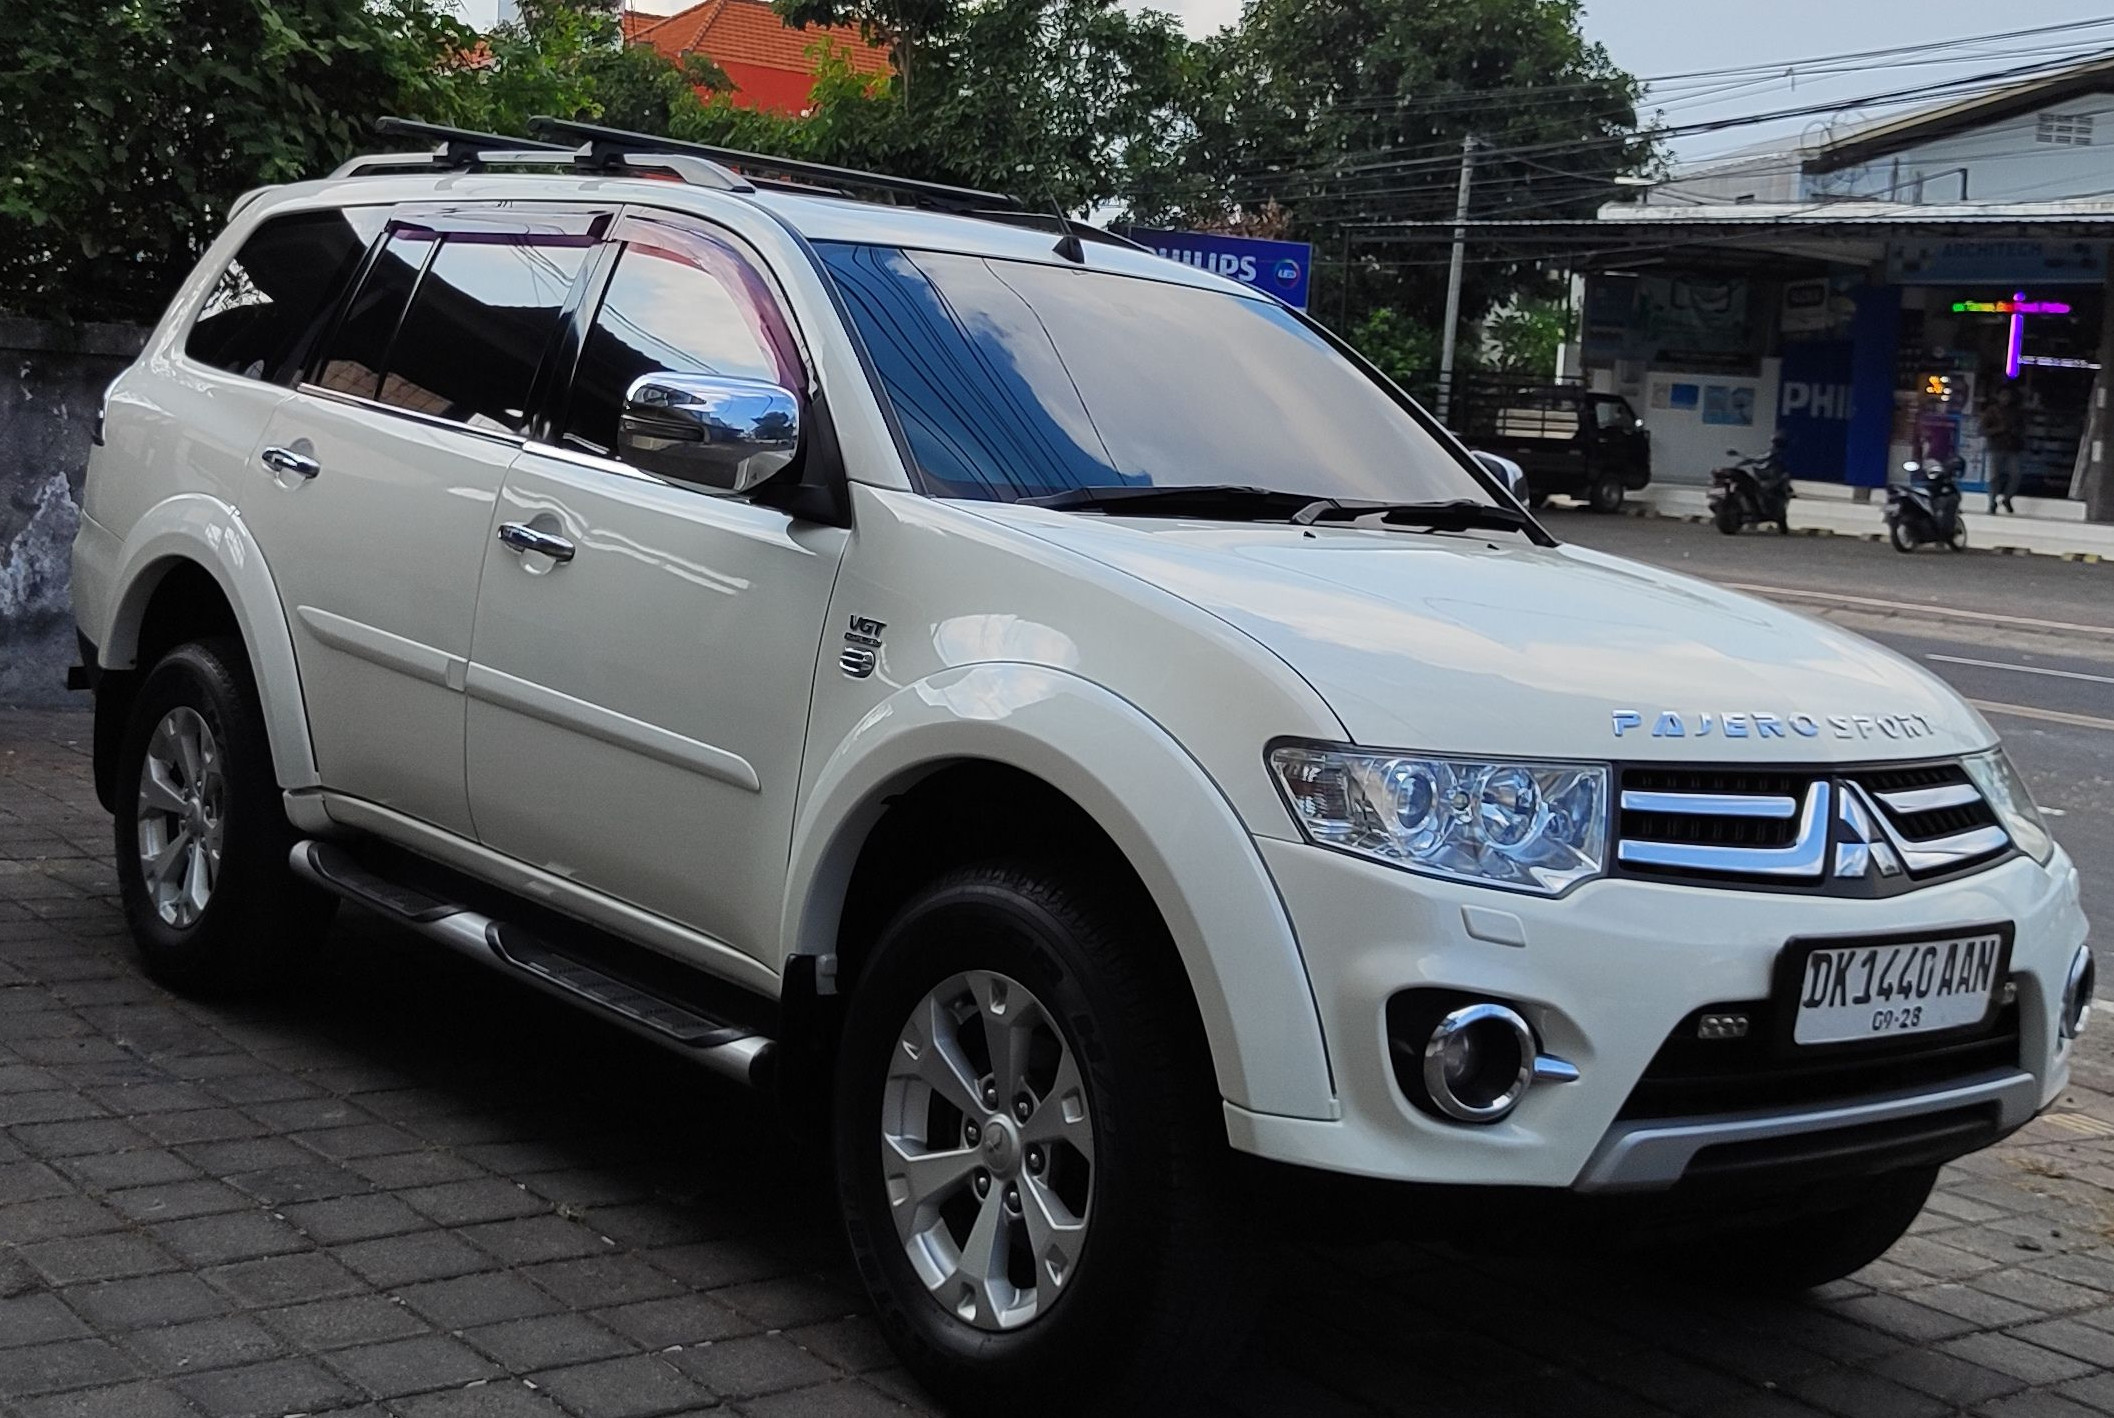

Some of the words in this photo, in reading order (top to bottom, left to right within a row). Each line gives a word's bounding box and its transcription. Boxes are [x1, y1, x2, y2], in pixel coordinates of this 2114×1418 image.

[1146, 247, 1257, 281] ILIPS
[850, 614, 887, 638] VGT
[1611, 709, 1820, 738] PAJERO
[1825, 712, 1934, 740] SPORT
[1802, 950, 1856, 1009] DK
[1852, 945, 1937, 1005] 1440
[1936, 939, 1996, 997] AAN
